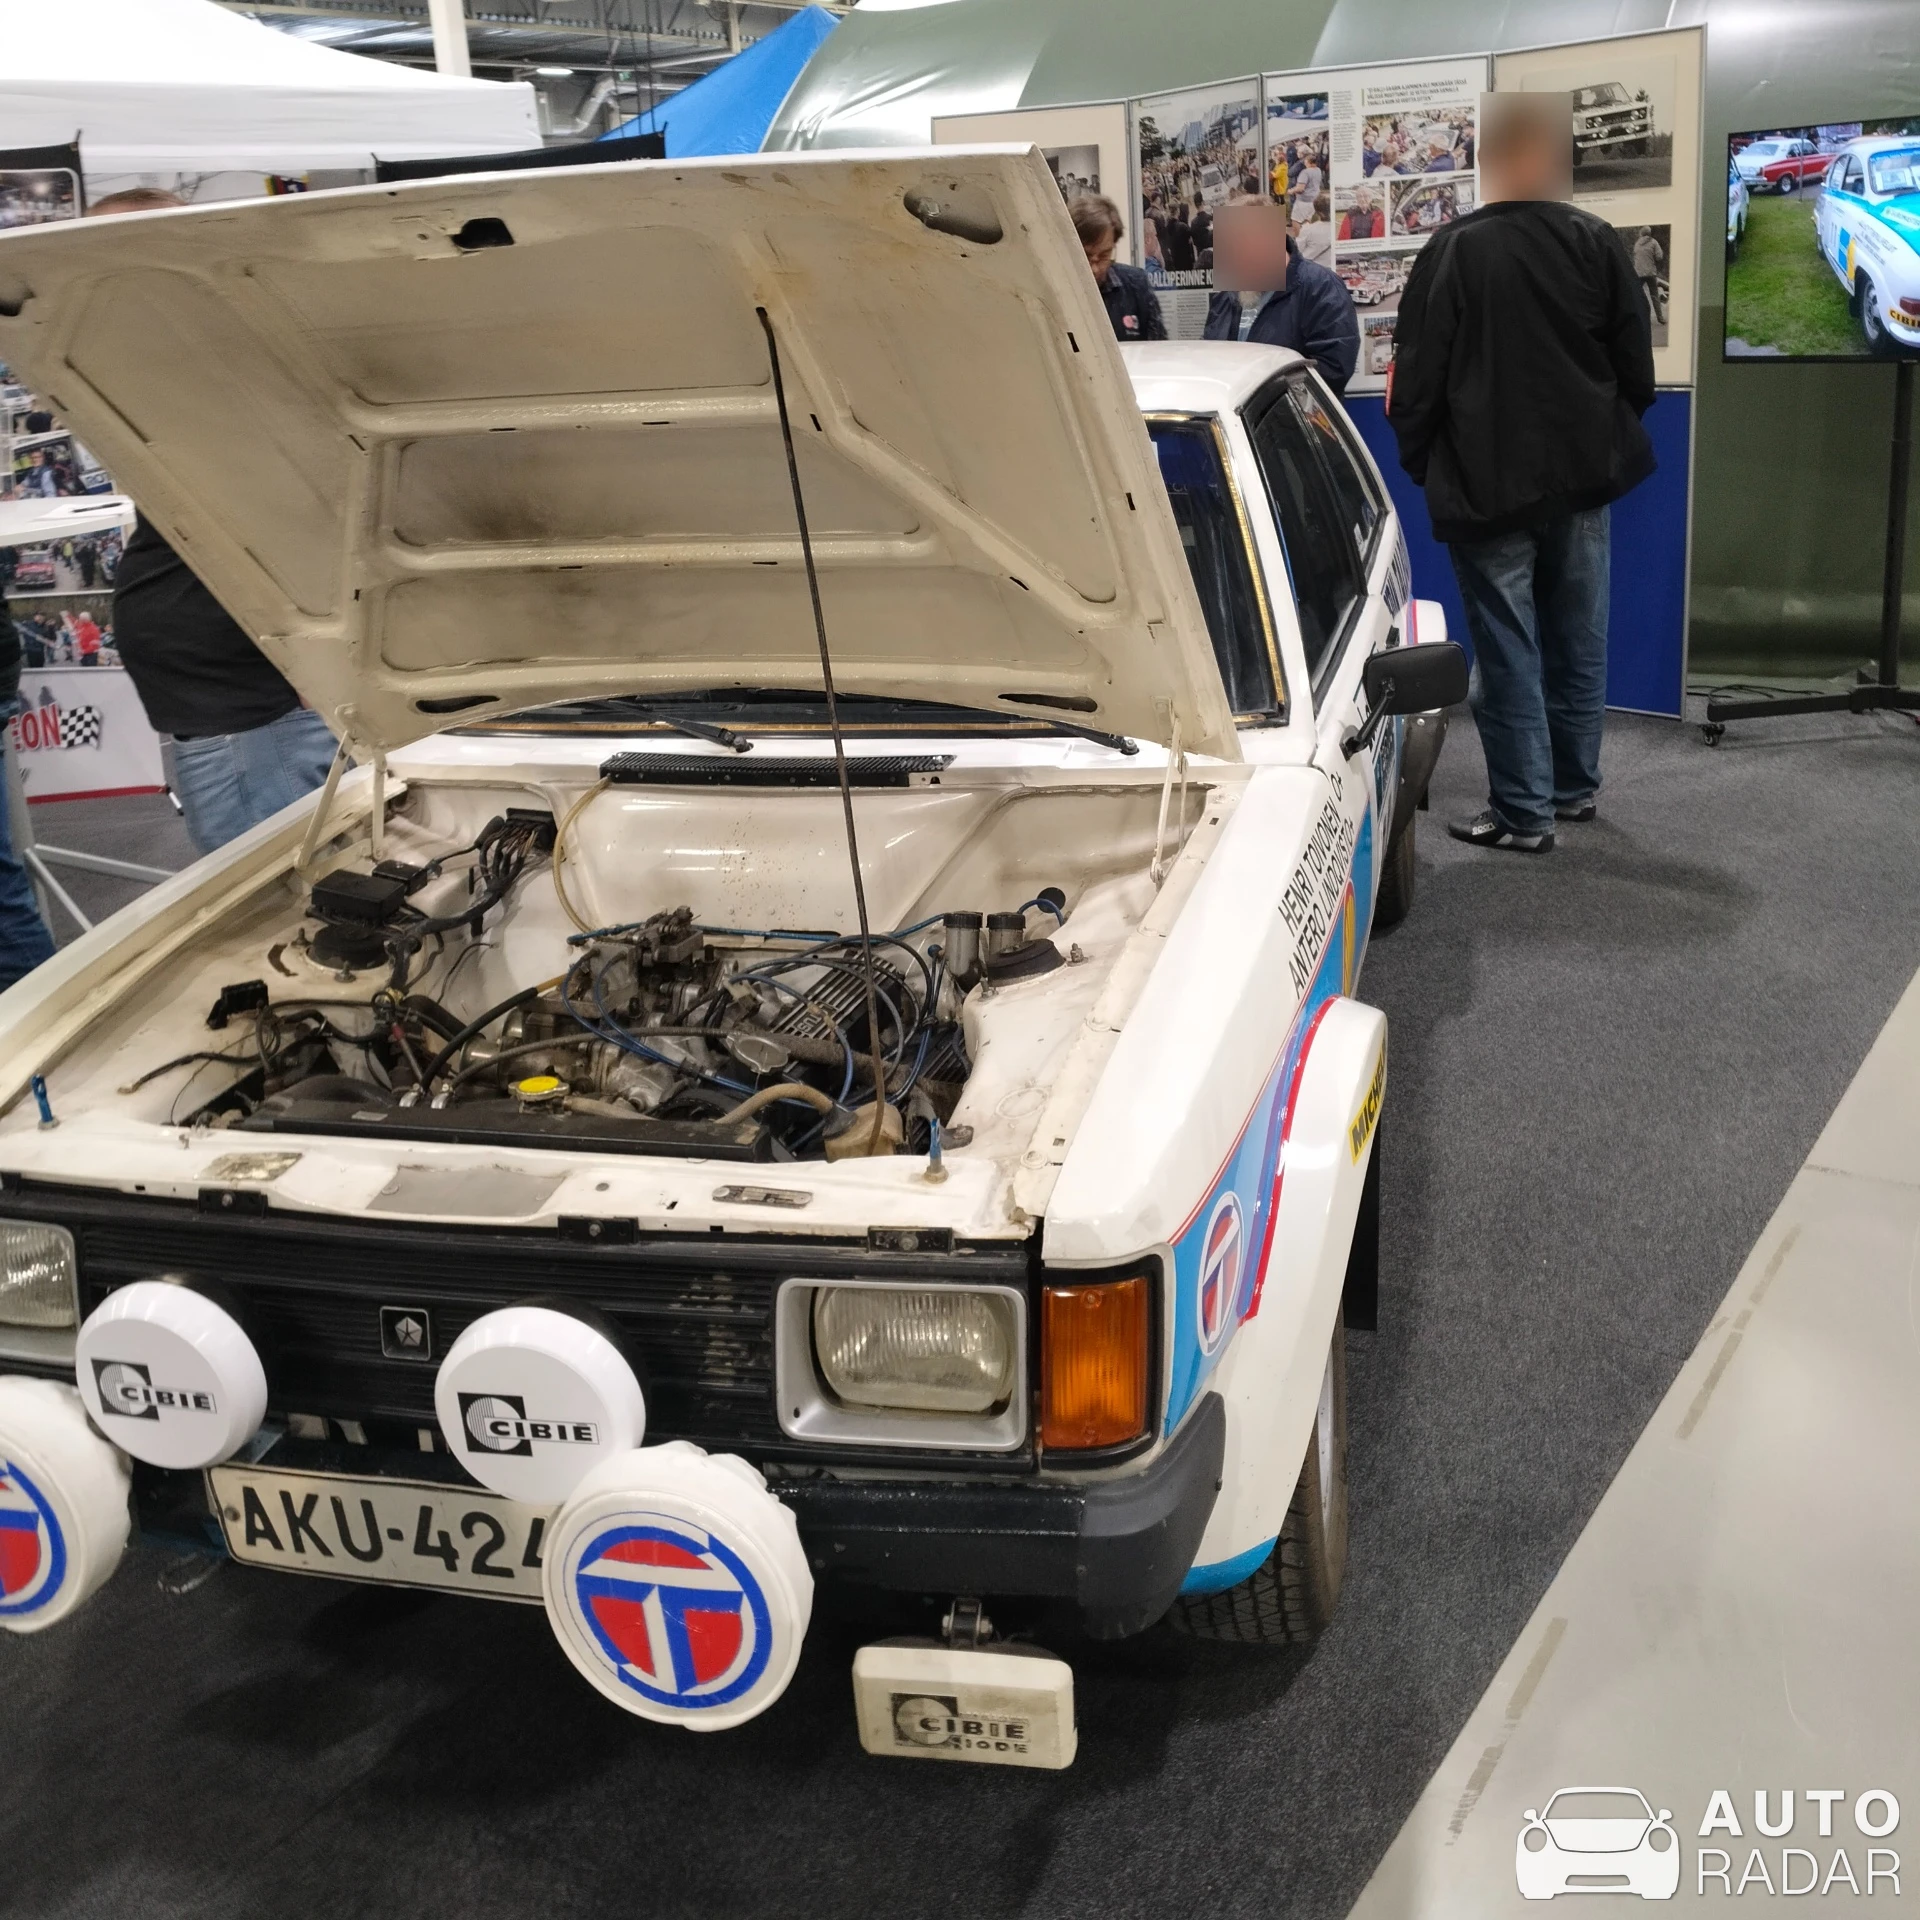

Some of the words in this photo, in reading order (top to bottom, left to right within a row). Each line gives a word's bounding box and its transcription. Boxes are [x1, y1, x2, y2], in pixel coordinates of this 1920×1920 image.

[1148, 269, 1206, 287] RALLIPERINNE
[1278, 863, 1315, 938] HENRI
[1303, 796, 1341, 883] TOIVONEN
[1288, 903, 1327, 1000] ANTERO
[1318, 825, 1351, 921] LINDQVIST
